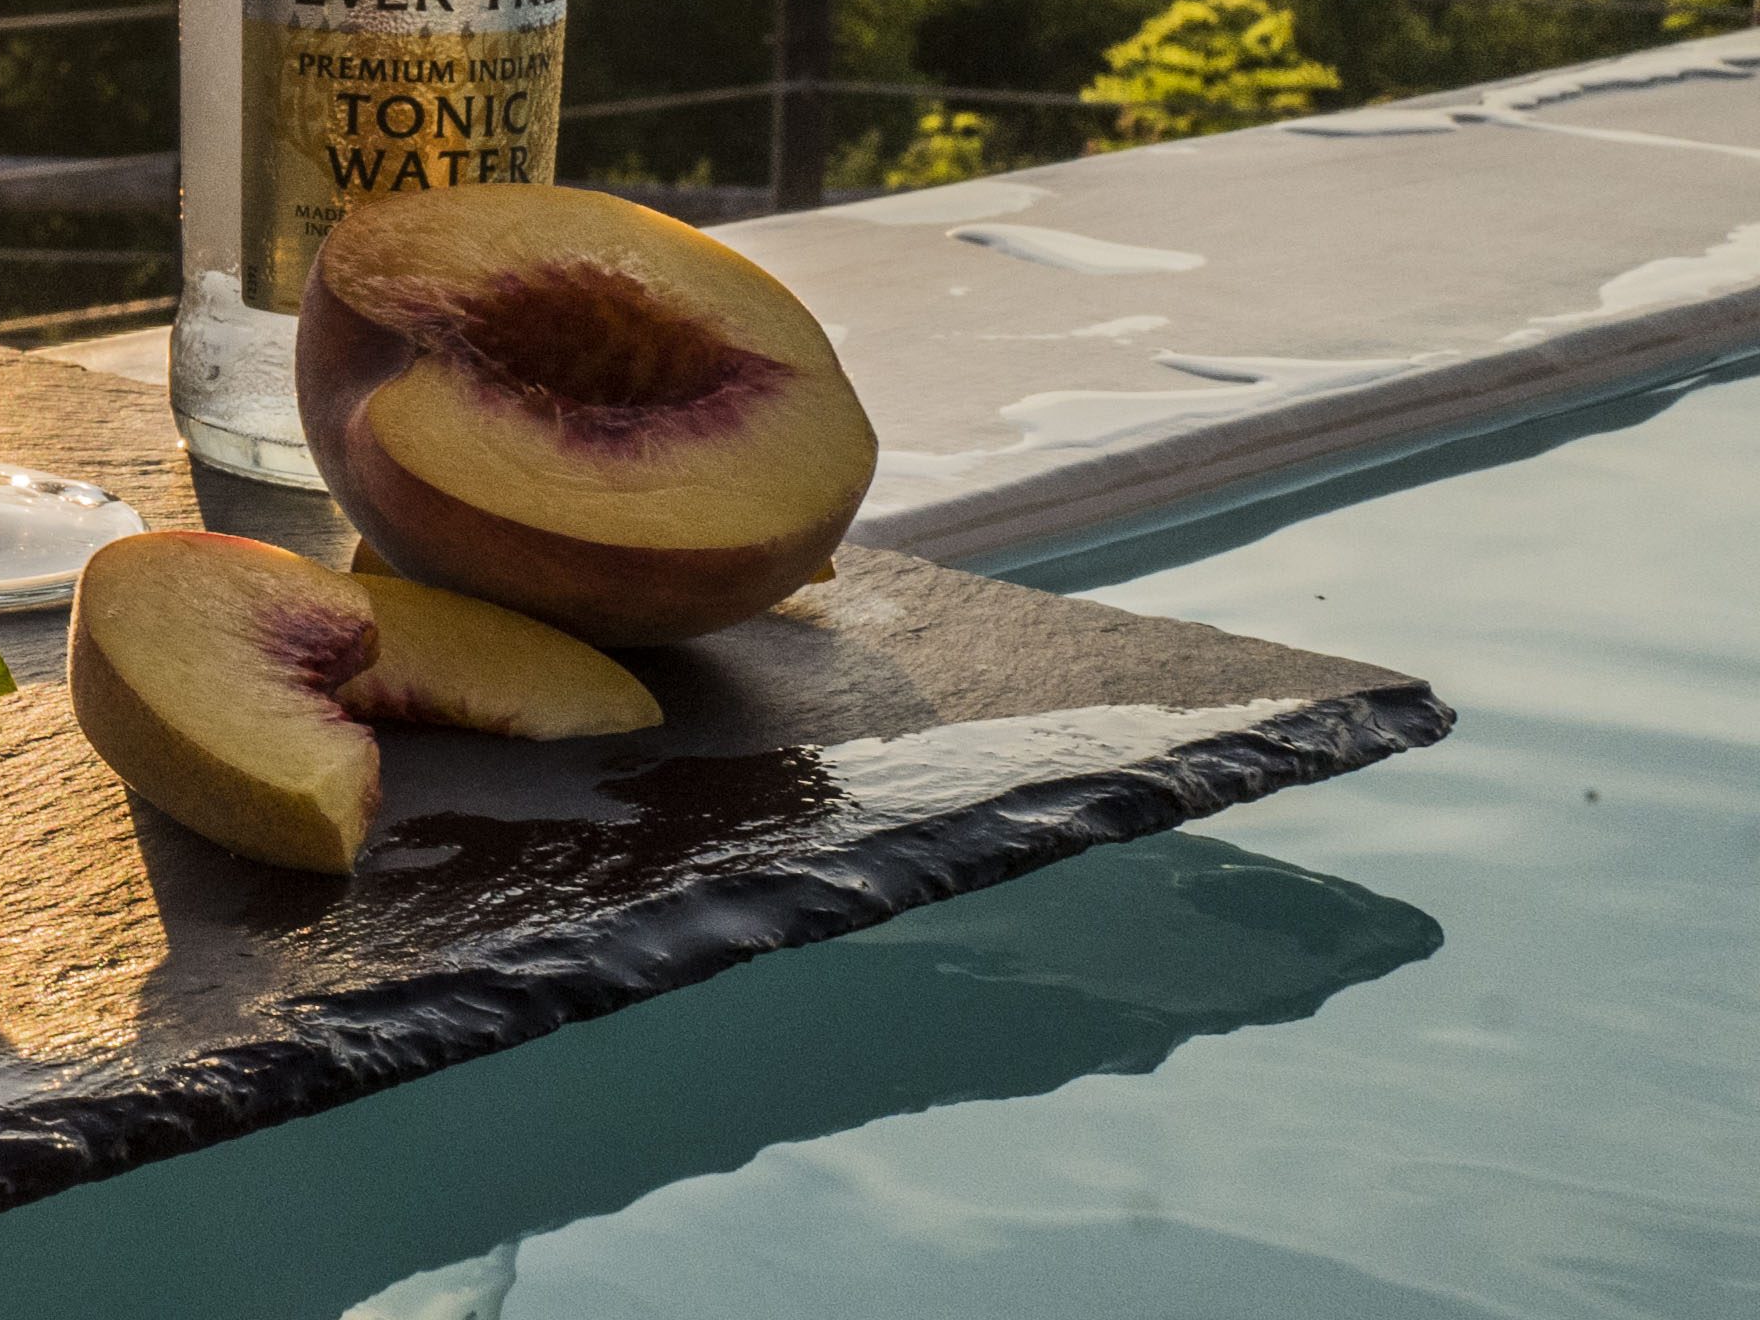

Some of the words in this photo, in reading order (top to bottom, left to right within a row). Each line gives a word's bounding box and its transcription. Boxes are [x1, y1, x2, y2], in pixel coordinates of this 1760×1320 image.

[298, 51, 456, 84] PREMIUM
[469, 52, 551, 82] INDIAN
[335, 90, 530, 140] TONIC
[325, 144, 532, 193] WATER
